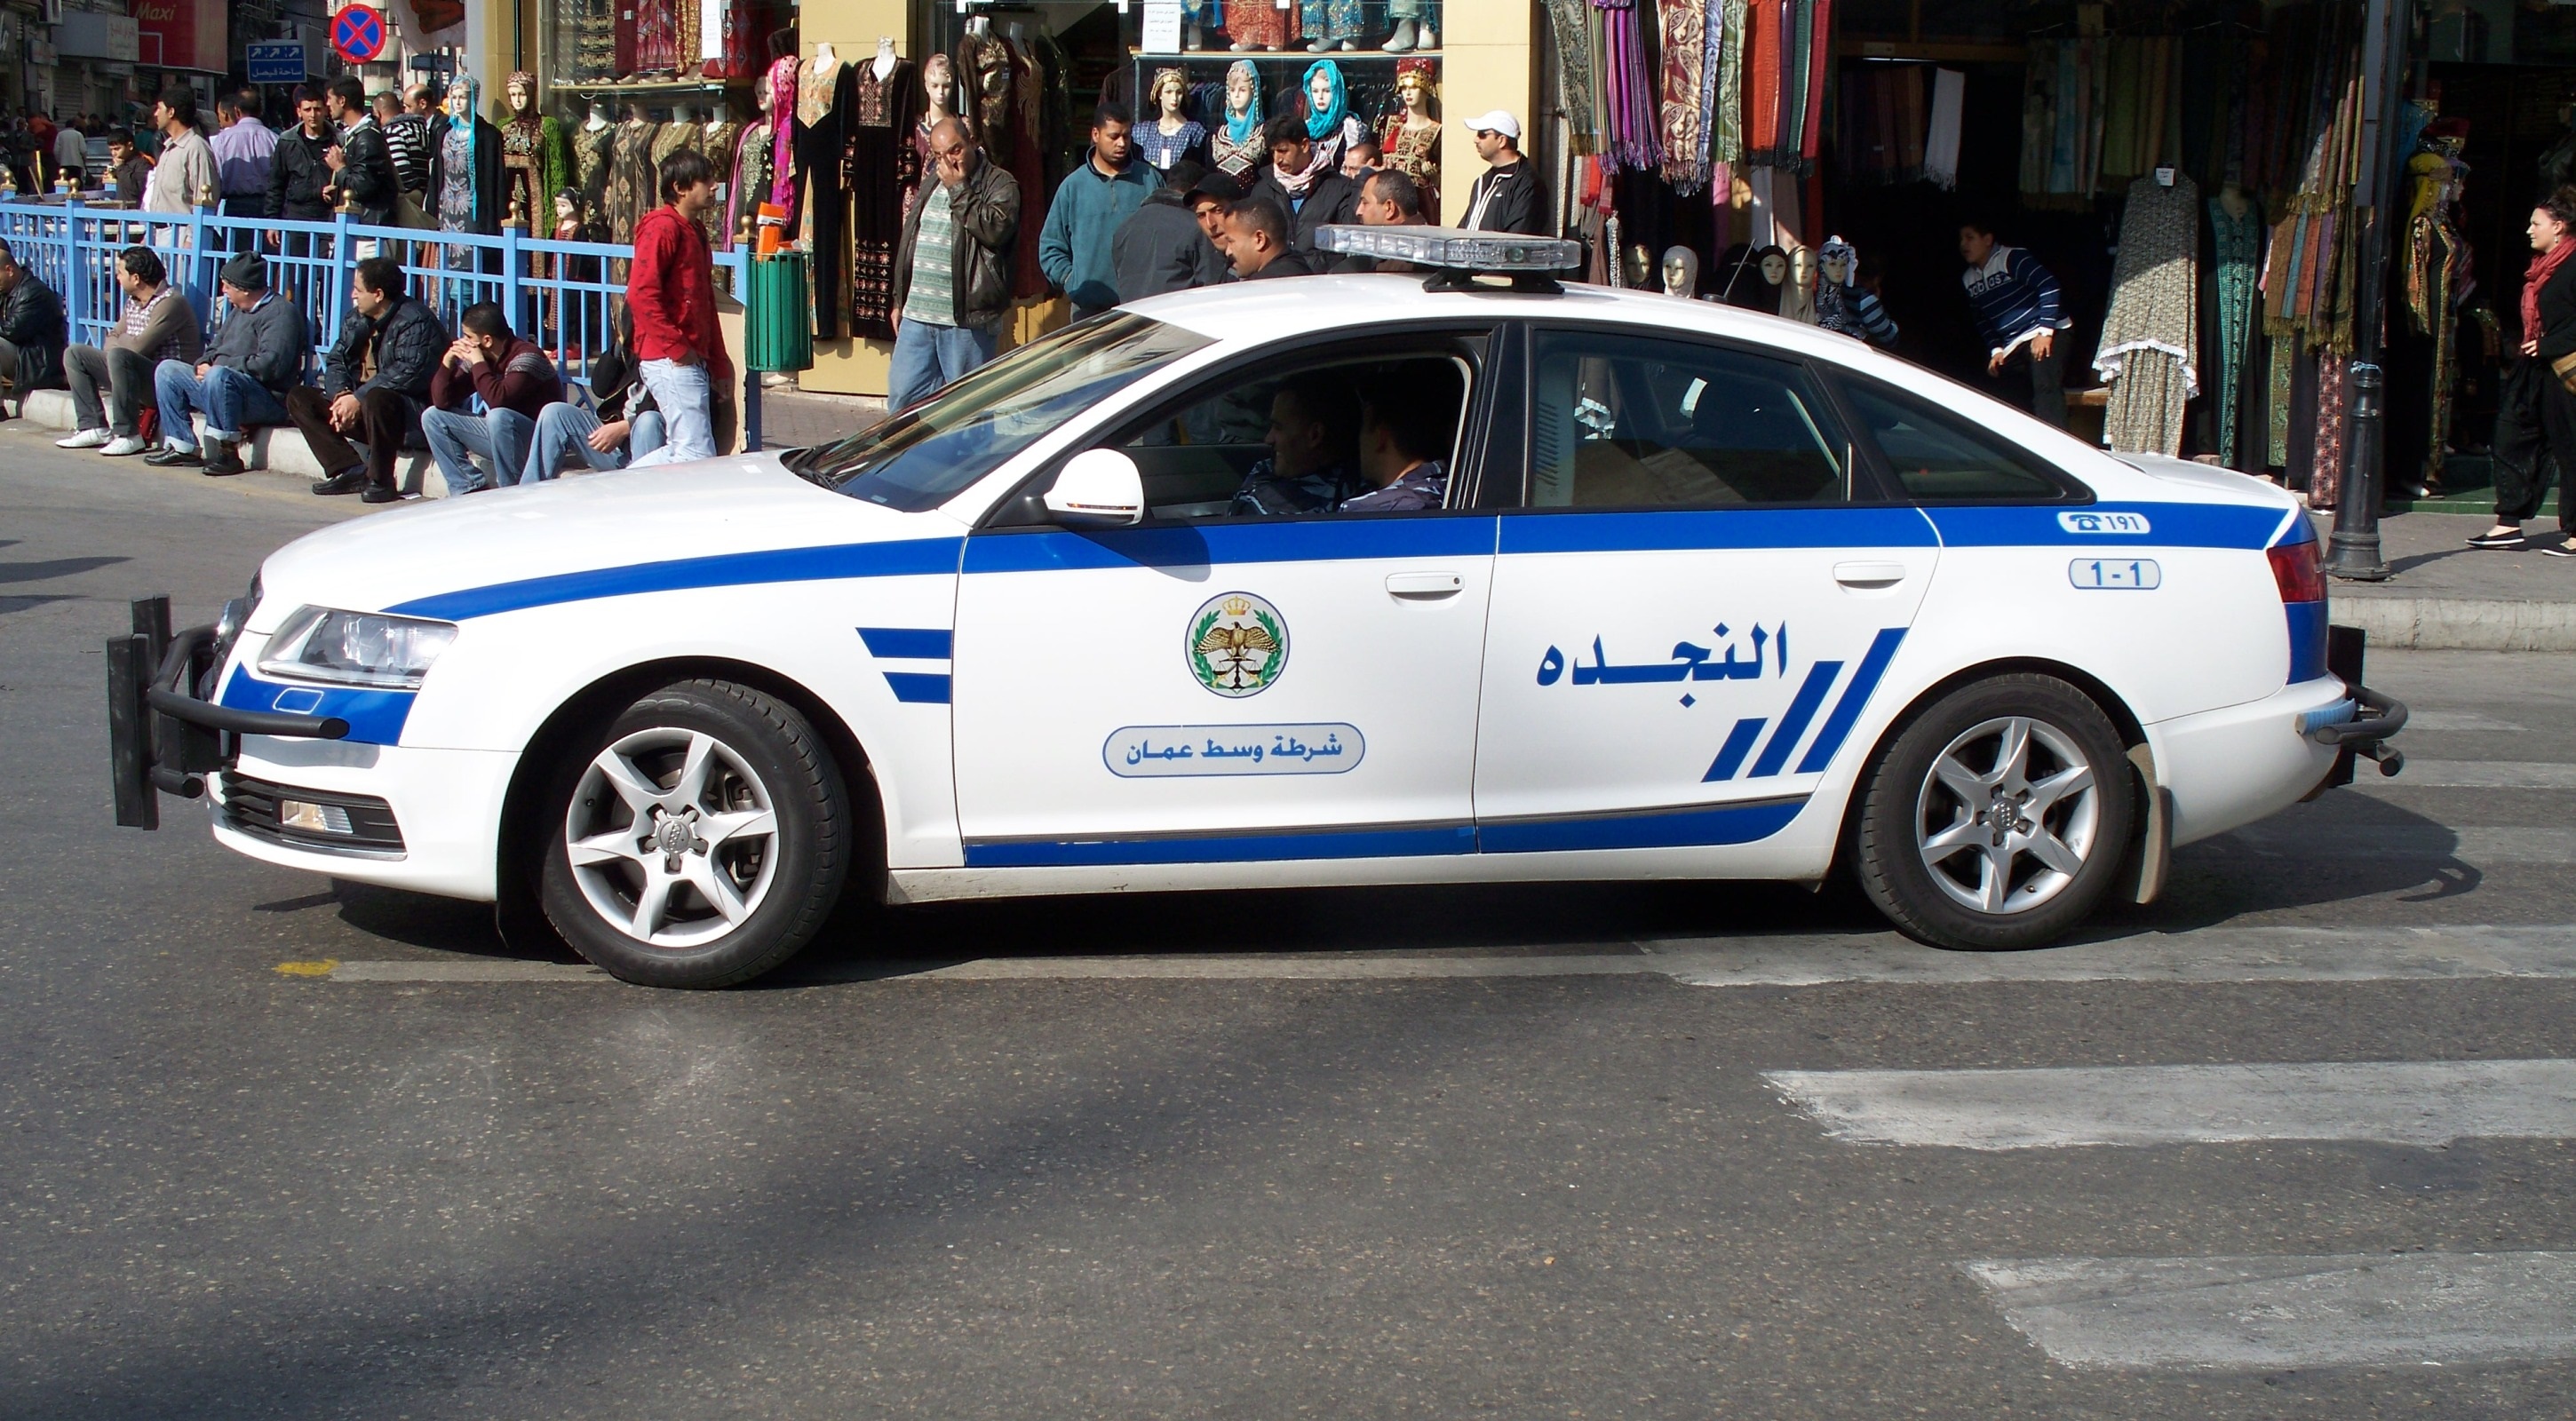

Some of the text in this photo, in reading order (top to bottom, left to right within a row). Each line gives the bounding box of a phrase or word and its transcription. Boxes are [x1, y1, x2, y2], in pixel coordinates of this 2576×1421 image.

[135, 2, 177, 21] Maxi
[251, 67, 278, 78] فيصل
[1536, 619, 1788, 710] النجده
[1125, 733, 1343, 766] شرطة وسط عمان
